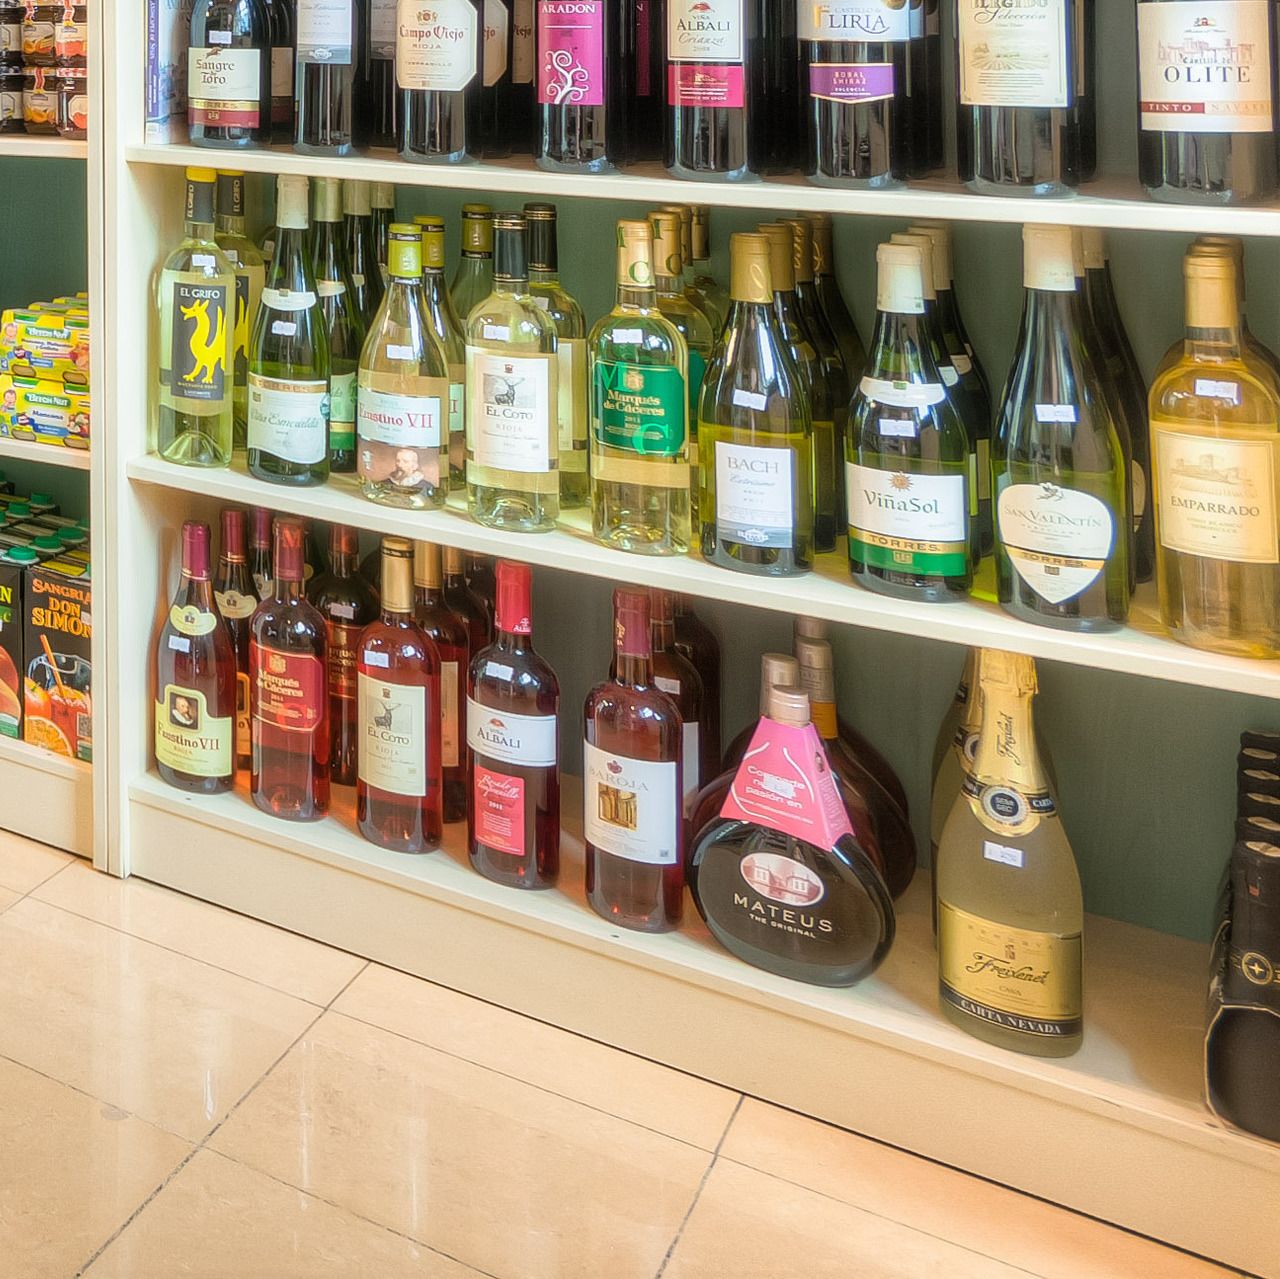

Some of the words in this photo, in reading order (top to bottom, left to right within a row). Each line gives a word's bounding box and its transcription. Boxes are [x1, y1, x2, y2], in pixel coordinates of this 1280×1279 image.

[541, 3, 596, 15] ARADON
[676, 21, 731, 32] ALBALI
[828, 13, 890, 34] LIRIA
[399, 25, 432, 42] Campo
[432, 26, 465, 42] Viejo
[412, 42, 442, 50] RIOJA
[196, 58, 235, 71] Sangre
[201, 72, 226, 85] Toro
[1164, 65, 1252, 83] OLITE
[1149, 103, 1192, 112] TINTO
[179, 287, 191, 297] EL
[192, 287, 221, 300] GRIFO
[607, 389, 661, 406] Marqués
[486, 405, 501, 417] EL
[502, 408, 534, 420] COTO
[615, 403, 665, 417] Cáceres
[407, 411, 432, 428] VII
[727, 456, 778, 475] BACH
[1170, 495, 1260, 518] EMPARRADO
[868, 534, 940, 553] TORRES
[1021, 551, 1087, 568] TORRES
[49, 598, 81, 616] DON
[157, 725, 198, 749] Faustino
[198, 738, 220, 751] VII
[368, 726, 380, 737] EL
[381, 731, 410, 745] COTO
[477, 727, 521, 749] ALBALI
[786, 799, 802, 809] en
[734, 893, 833, 932] MATEUS
[749, 913, 766, 924] THE
[771, 920, 816, 938] ORIGINAL
[966, 952, 1049, 986] Freixenet
[961, 999, 1001, 1019] CARTA
[1006, 1012, 1061, 1034] NEVADA
